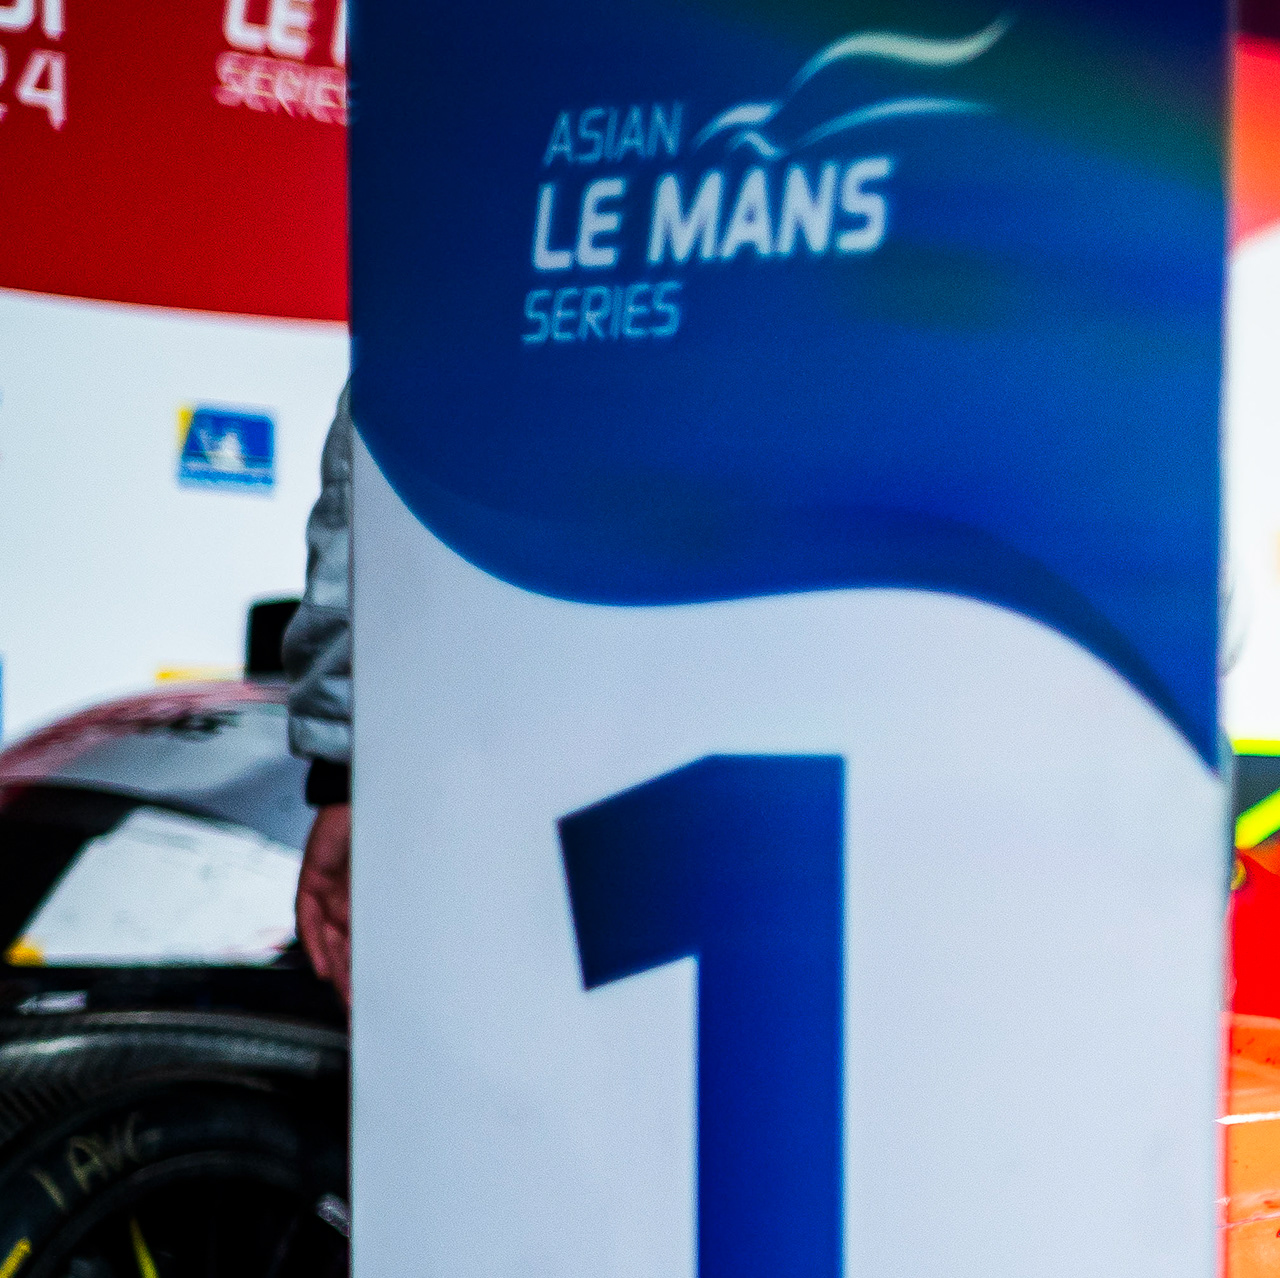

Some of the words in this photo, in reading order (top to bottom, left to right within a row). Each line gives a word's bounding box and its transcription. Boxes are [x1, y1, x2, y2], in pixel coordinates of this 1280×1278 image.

[213, 50, 347, 125] SERIE
[543, 102, 684, 165] ASIAN
[533, 176, 627, 269] LE
[646, 156, 892, 264] MANS
[521, 281, 682, 344] SERIES
